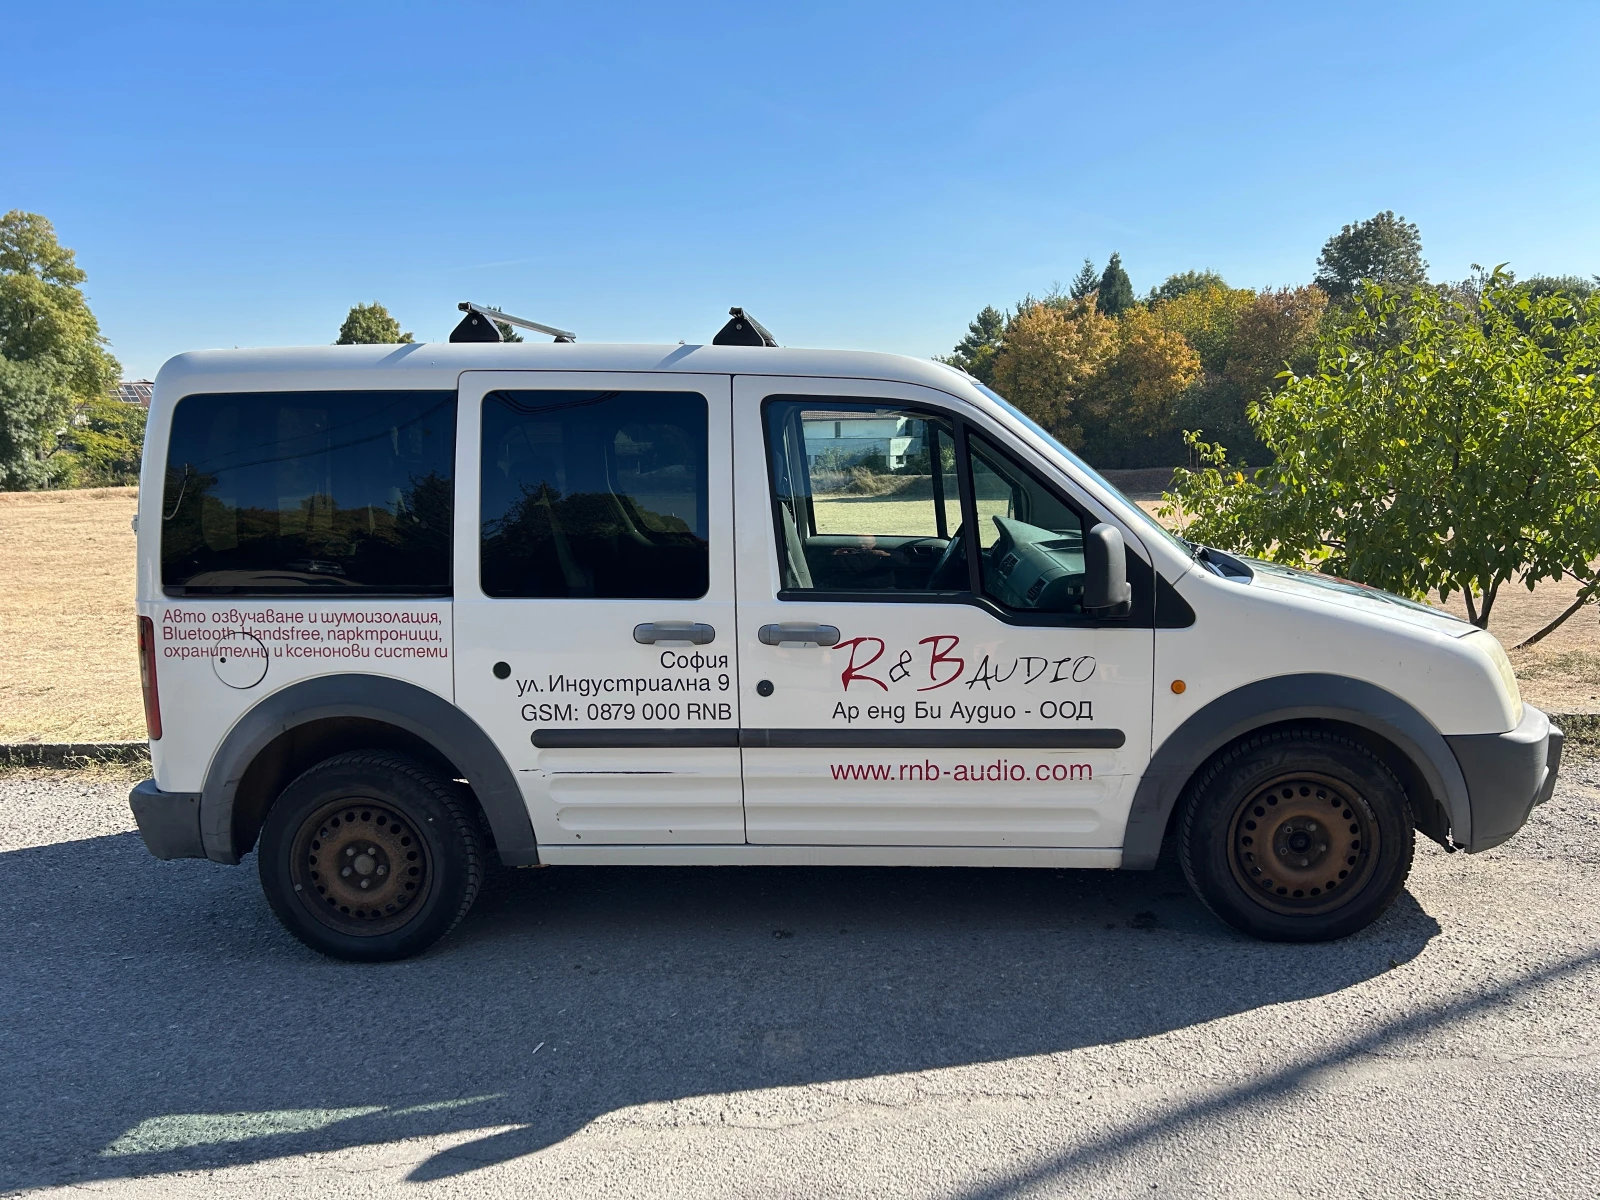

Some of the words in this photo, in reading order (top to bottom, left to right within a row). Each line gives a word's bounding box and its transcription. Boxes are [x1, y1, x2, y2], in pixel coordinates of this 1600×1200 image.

[162, 609, 206, 624] Авто
[212, 609, 304, 626] озвучаване
[308, 612, 317, 623] и
[321, 611, 443, 626] шумоизолация,
[163, 627, 235, 641] Bluetooth
[242, 627, 324, 642] Handsfree,
[164, 646, 268, 661] охранителни
[274, 646, 282, 658] и
[286, 644, 370, 658] ксенонови
[374, 647, 449, 659] системи
[660, 651, 729, 672] София
[516, 678, 545, 697] ул.
[549, 675, 711, 696] Индустриална
[718, 674, 730, 691] 9
[521, 703, 579, 722] GSM:
[587, 703, 636, 721] 0879
[642, 703, 680, 721] 000
[687, 703, 732, 720] RNB
[832, 701, 860, 723] Ар
[868, 704, 906, 723] енд
[915, 702, 942, 719] Би
[950, 701, 1016, 723] Аудио
[1039, 700, 1094, 720] ООД
[830, 759, 1093, 781] www.rnb-audio.com
